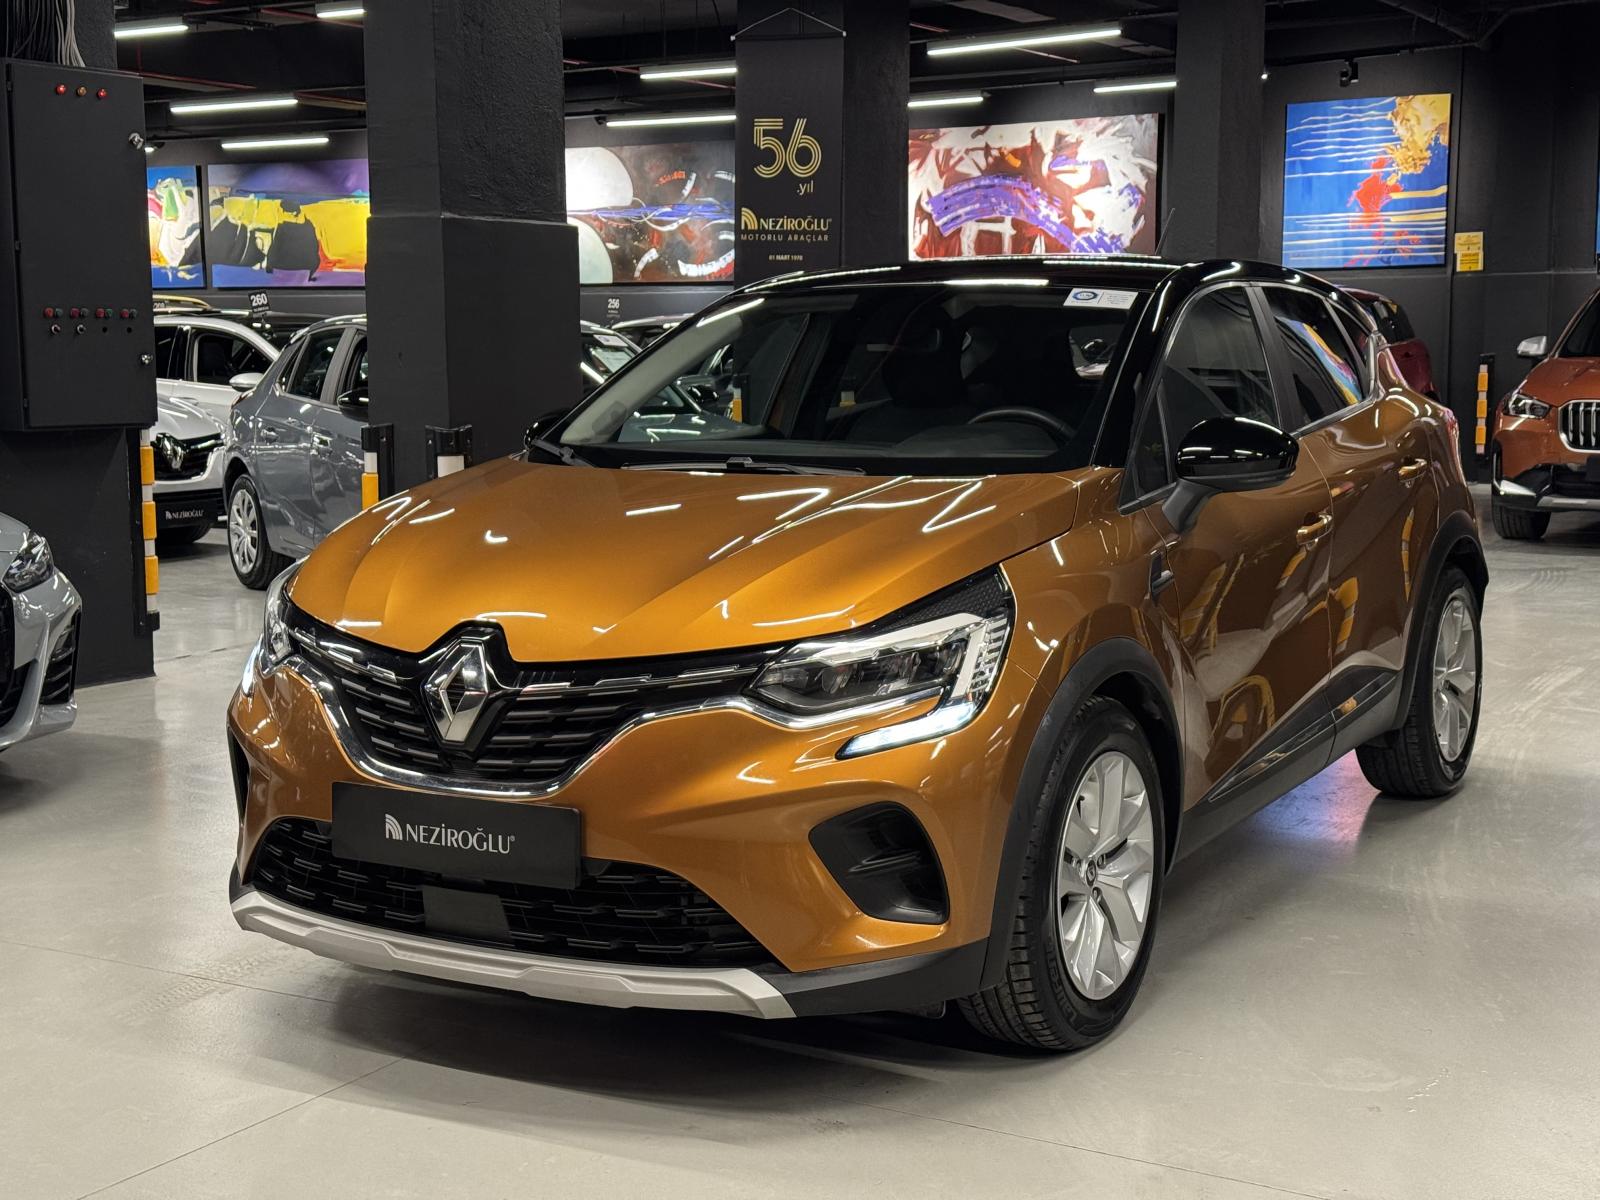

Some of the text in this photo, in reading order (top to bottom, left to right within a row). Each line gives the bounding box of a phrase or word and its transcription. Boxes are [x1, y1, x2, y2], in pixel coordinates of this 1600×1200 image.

[753, 118, 822, 178] 56
[741, 233, 829, 243] MOTORLU ARAÇLAR
[250, 293, 268, 307] 260
